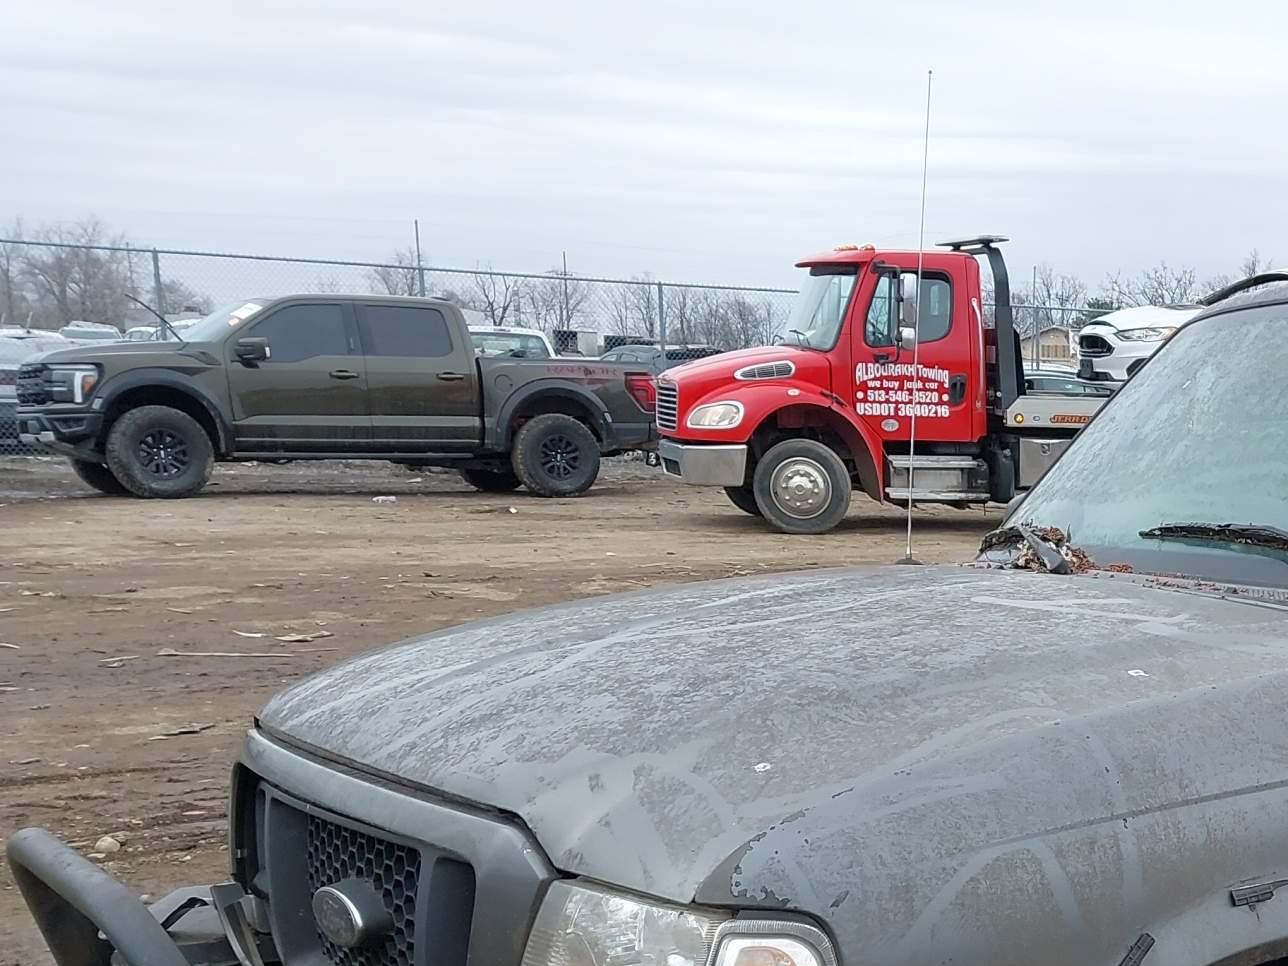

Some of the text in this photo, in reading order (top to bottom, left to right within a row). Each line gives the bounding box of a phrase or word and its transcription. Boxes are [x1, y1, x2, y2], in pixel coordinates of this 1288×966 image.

[917, 364, 949, 388] Towing
[867, 380, 881, 388] we
[883, 379, 899, 390] buy
[856, 403, 950, 418] USDOT 3640216
